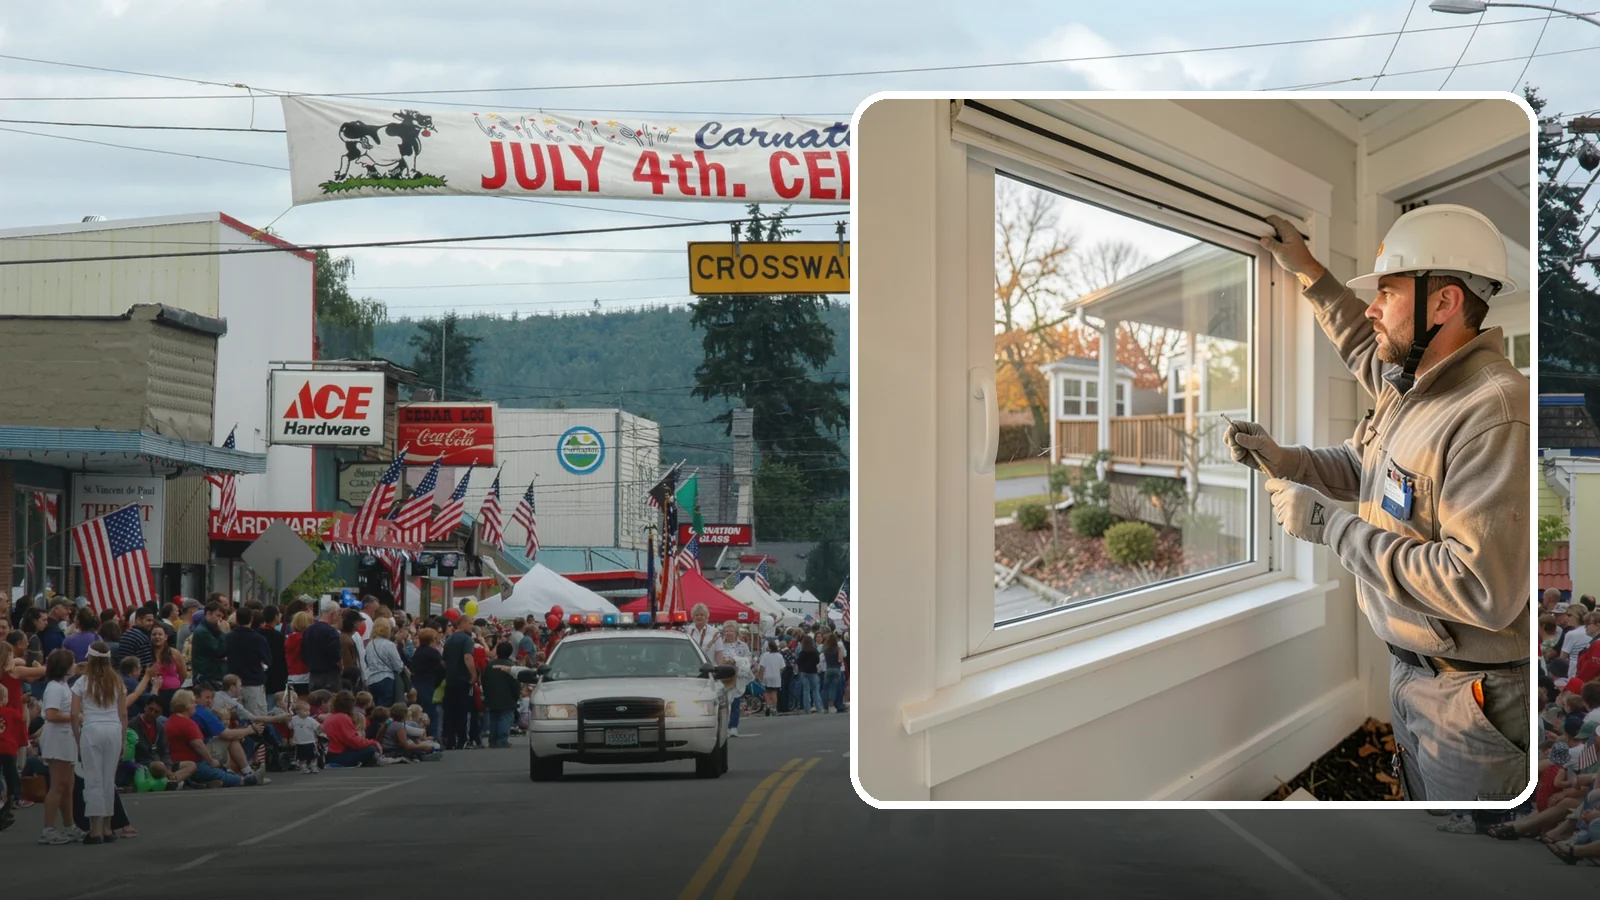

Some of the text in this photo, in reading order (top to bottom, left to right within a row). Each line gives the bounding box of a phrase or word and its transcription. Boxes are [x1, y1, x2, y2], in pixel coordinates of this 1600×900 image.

[481, 141, 605, 192] JULY
[632, 150, 747, 198] 4th.
[696, 254, 850, 280] CROSSWA
[282, 380, 373, 420] ACE
[405, 409, 452, 422] CEDAR
[283, 421, 371, 436] Hardware
[416, 428, 477, 446] Coca-Cola
[96, 486, 124, 494] Vincent
[126, 486, 135, 494] de
[212, 516, 330, 535] HARDARE
[688, 526, 741, 535] CRNATION
[699, 535, 730, 543] GLASS
